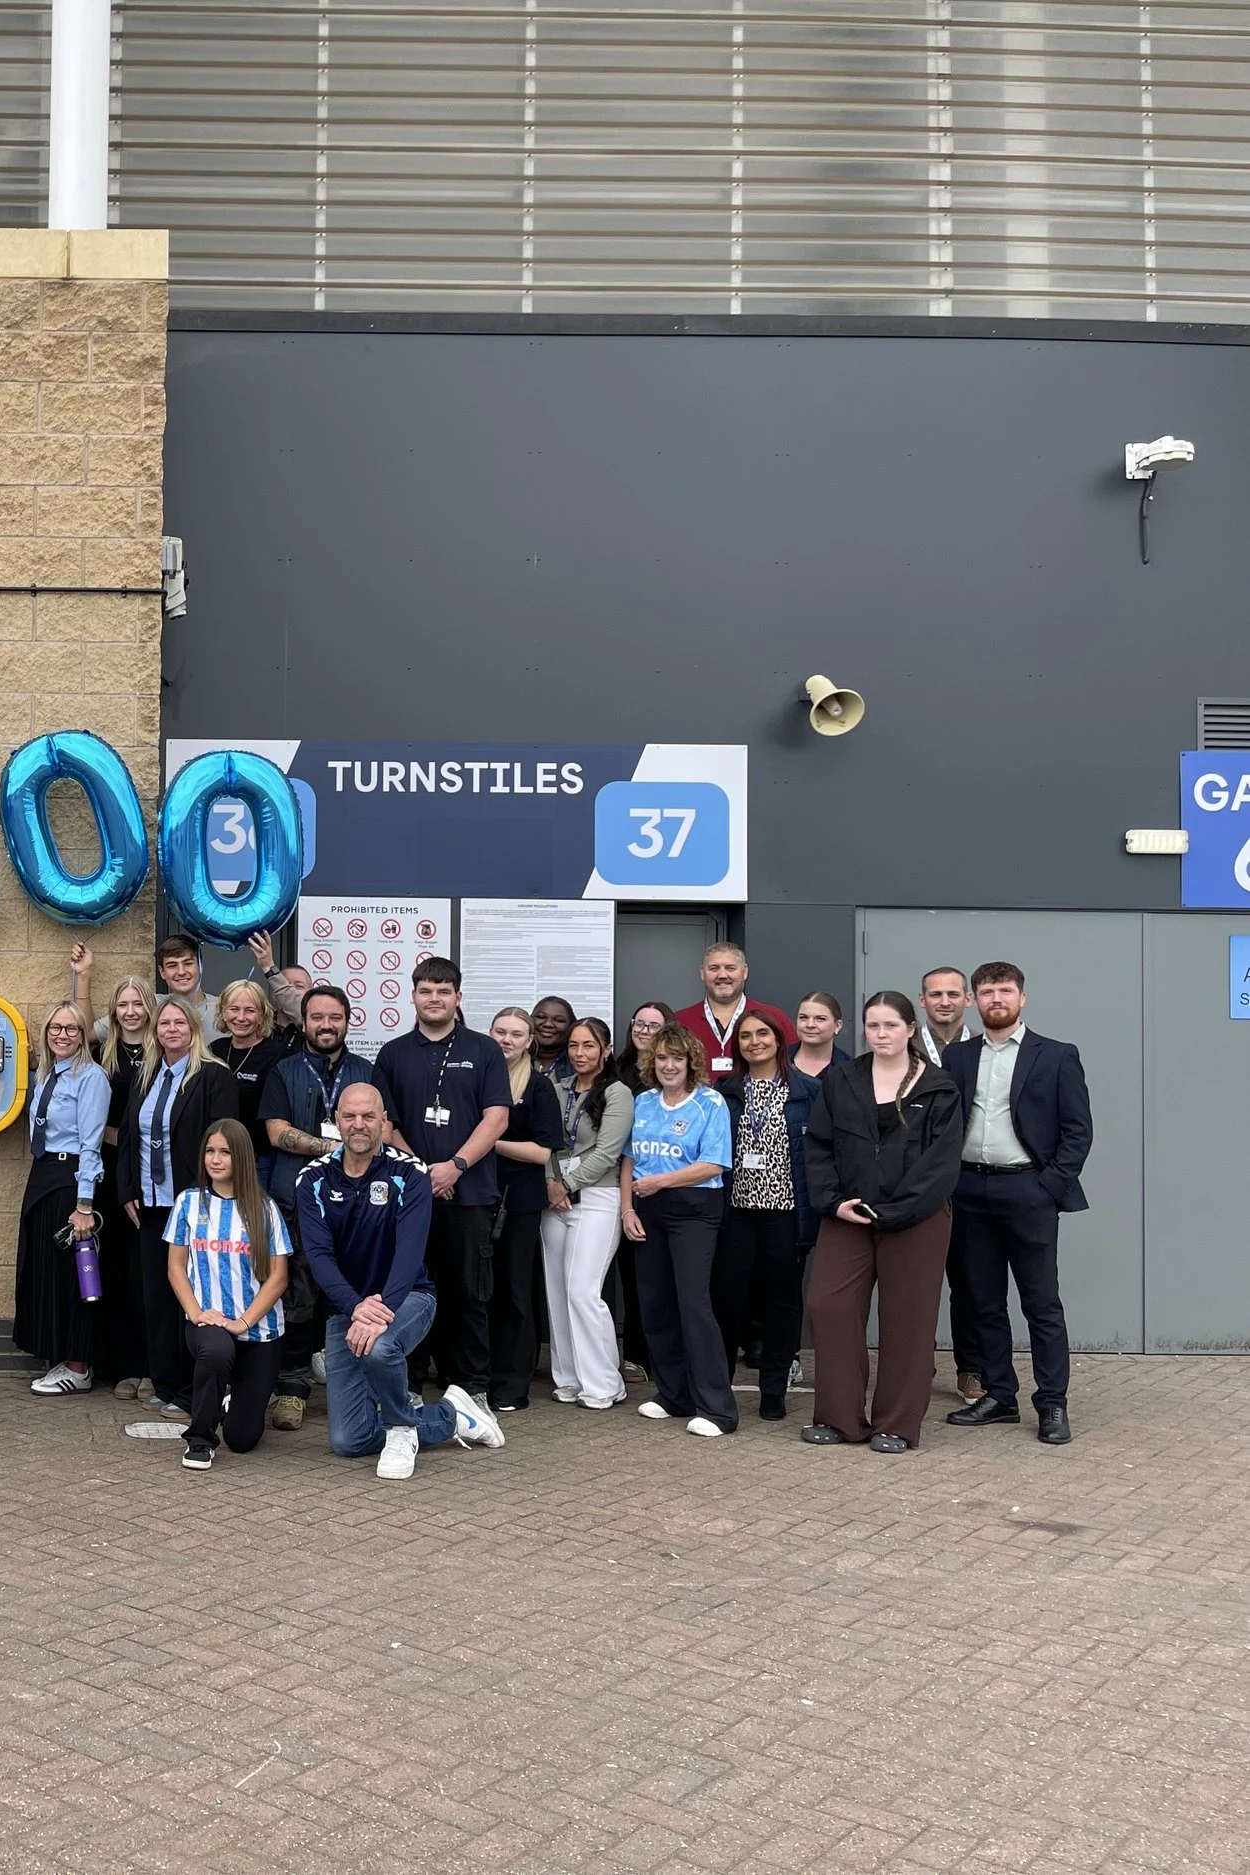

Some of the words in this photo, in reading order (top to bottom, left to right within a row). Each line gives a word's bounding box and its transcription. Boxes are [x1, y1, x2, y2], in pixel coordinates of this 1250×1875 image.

[327, 760, 584, 795] TURNSTILES
[210, 804, 255, 854] 3
[626, 808, 696, 858] 37
[330, 905, 388, 914] PROHIBITED
[390, 906, 419, 915] ITEMS
